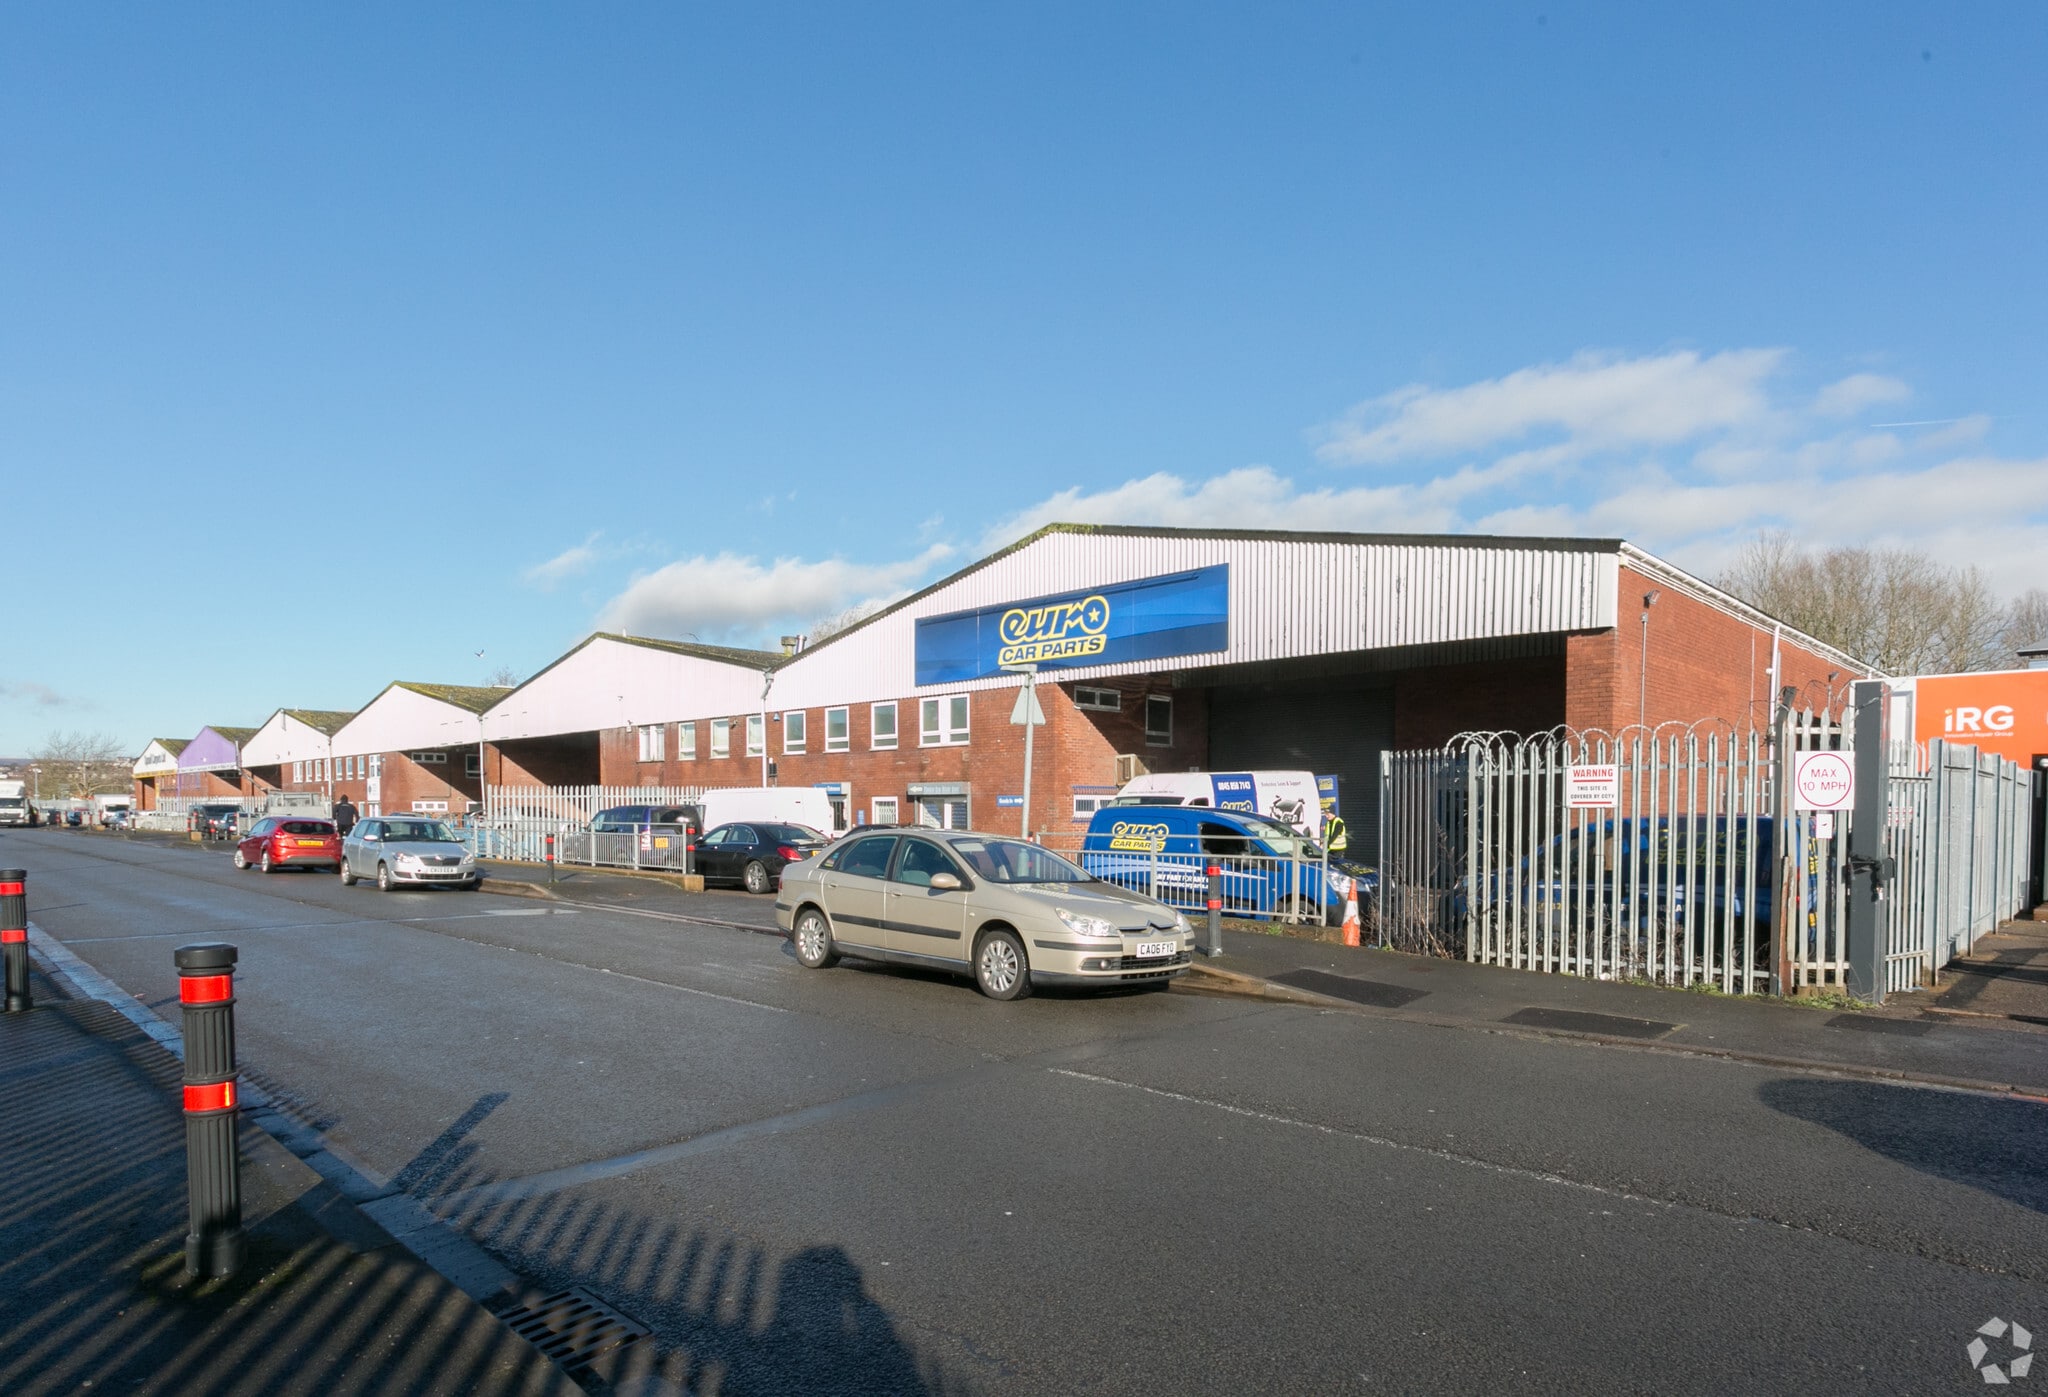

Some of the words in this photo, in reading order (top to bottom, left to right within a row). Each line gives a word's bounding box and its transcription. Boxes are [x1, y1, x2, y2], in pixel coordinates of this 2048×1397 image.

[999, 595, 1110, 646] euro
[1002, 646, 1037, 663] CAR
[1041, 637, 1102, 658] PARTS
[1944, 705, 2014, 732] iRG
[1573, 768, 1614, 777] WARNING
[1811, 768, 1837, 778] MAX
[1803, 781, 1815, 791] 10
[1820, 781, 1847, 791] MPH
[1140, 944, 1161, 955] CA06
